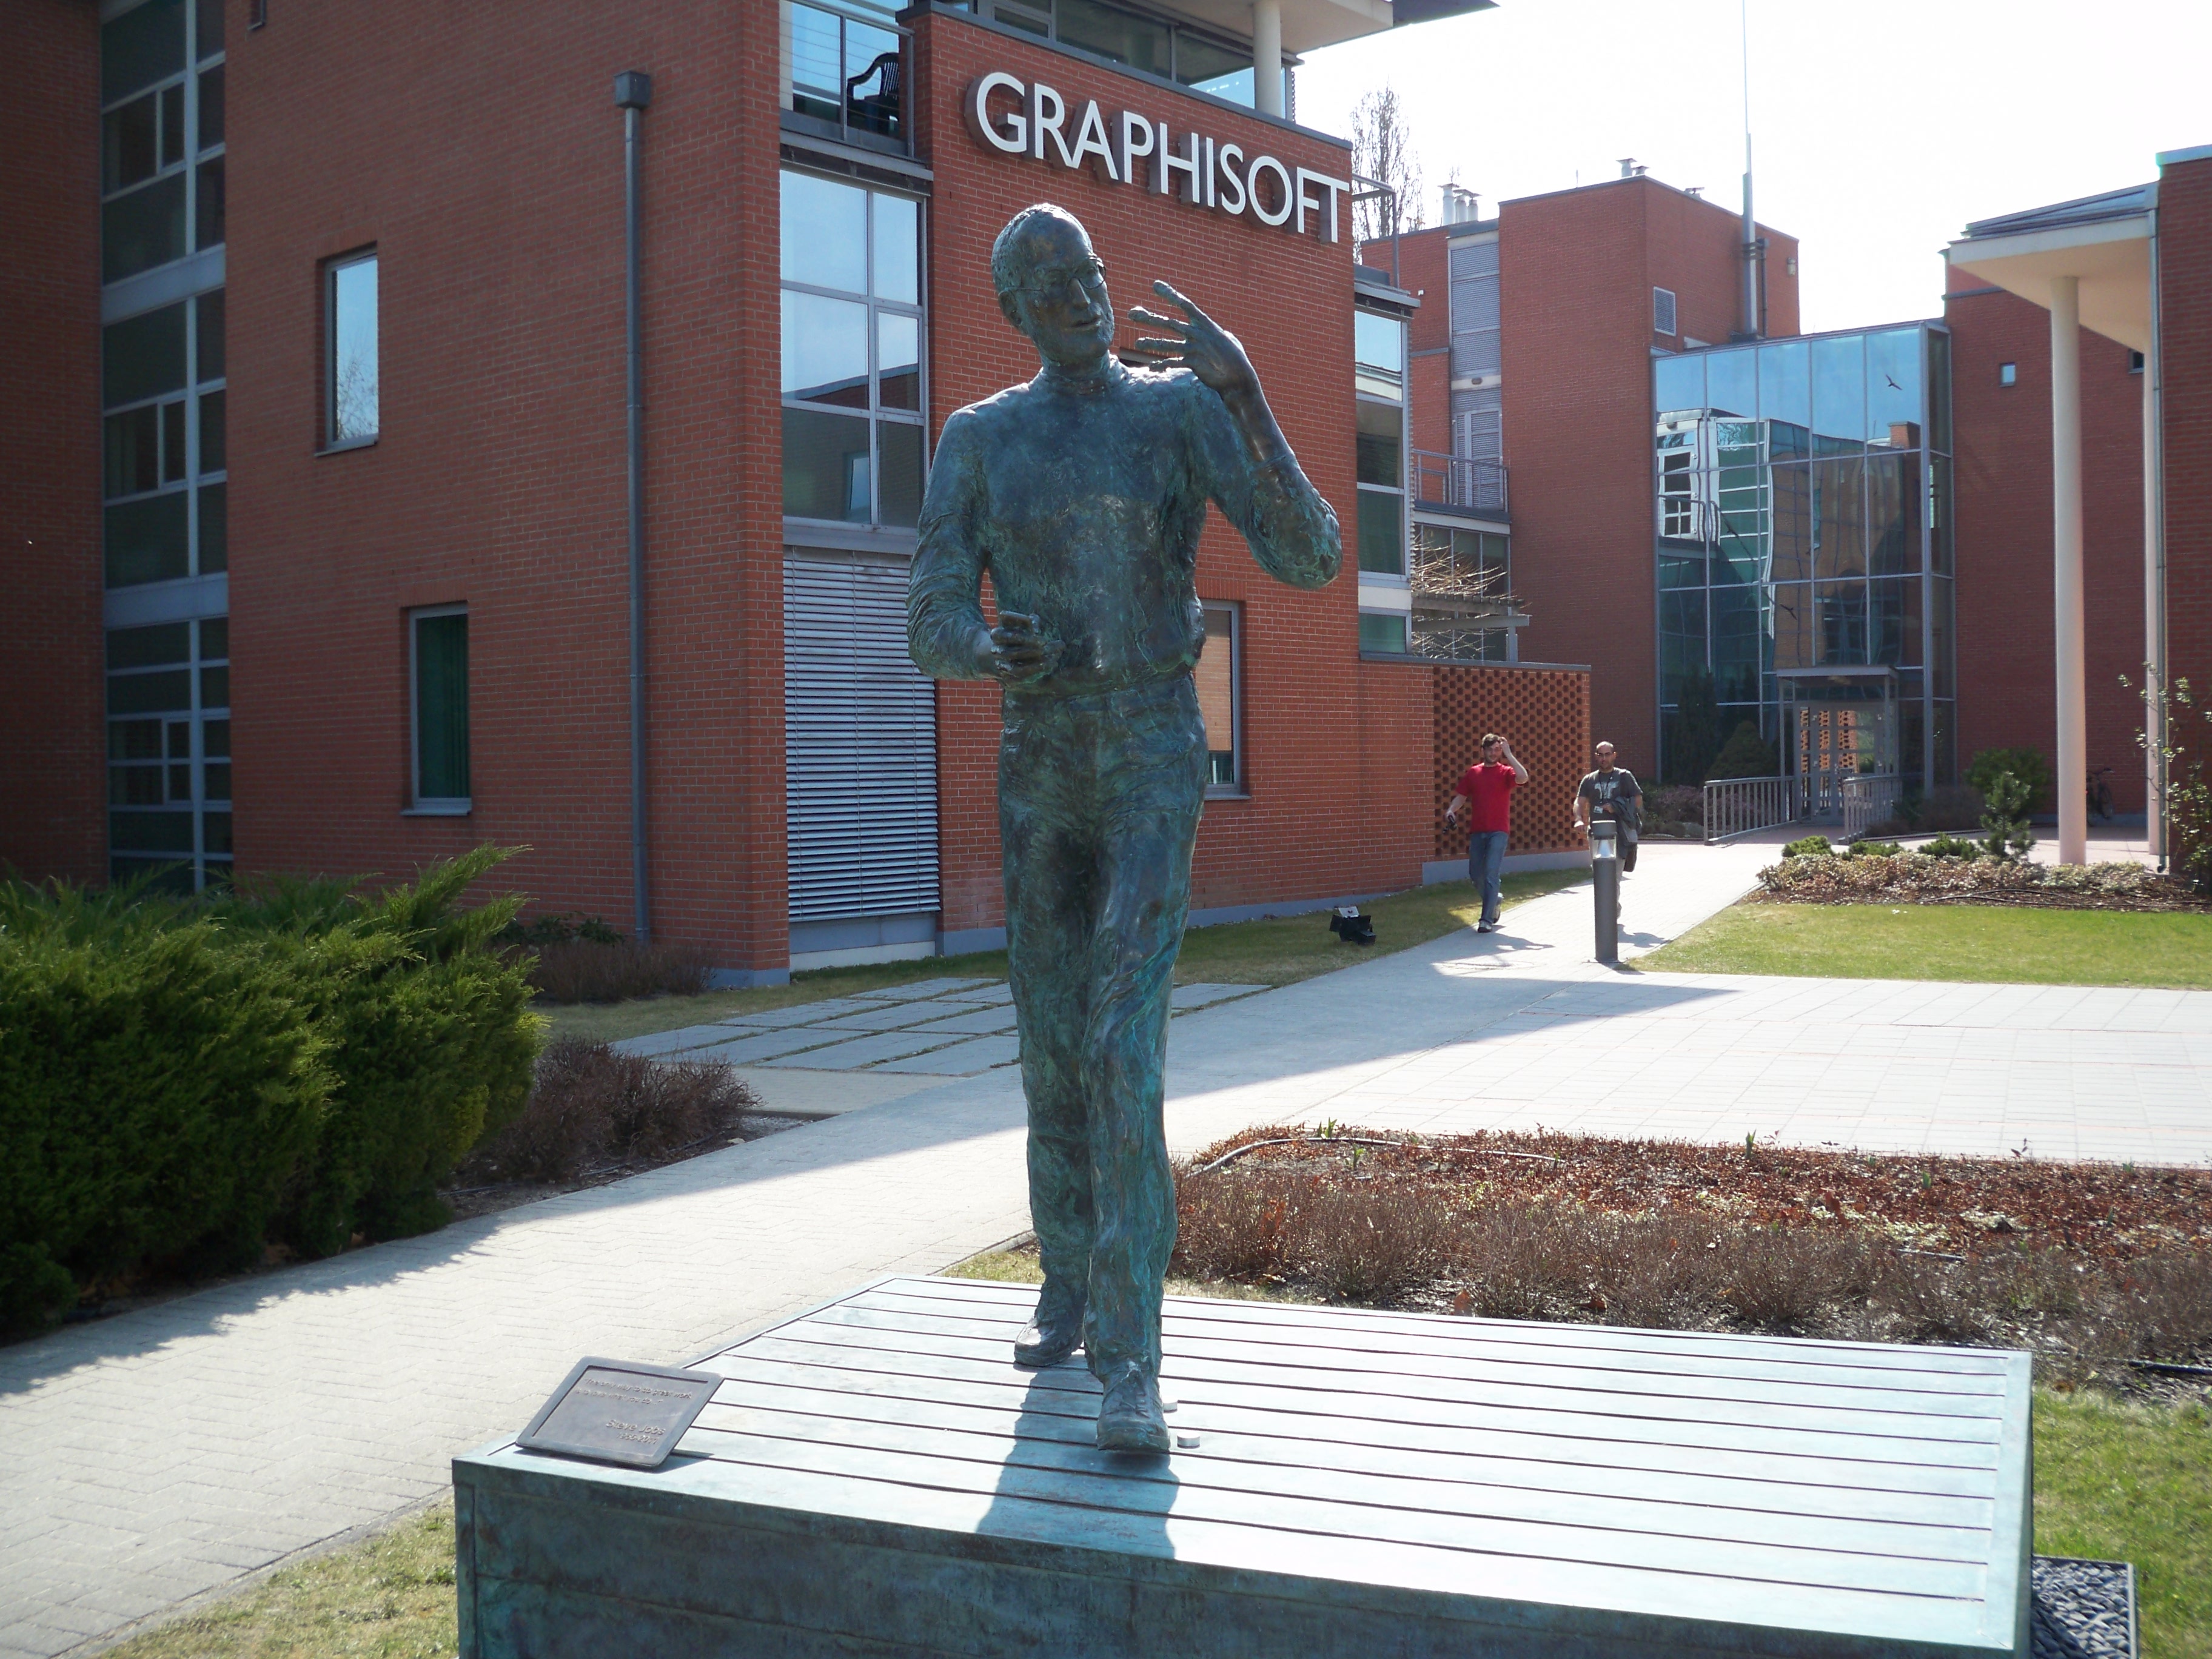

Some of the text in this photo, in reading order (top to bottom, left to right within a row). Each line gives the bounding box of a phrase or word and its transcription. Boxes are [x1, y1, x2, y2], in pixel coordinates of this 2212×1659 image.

[973, 72, 1350, 243] GRAPHISOFT
[606, 1419, 666, 1435] Steve Jobs
[616, 1432, 660, 1444] 1955-2011
